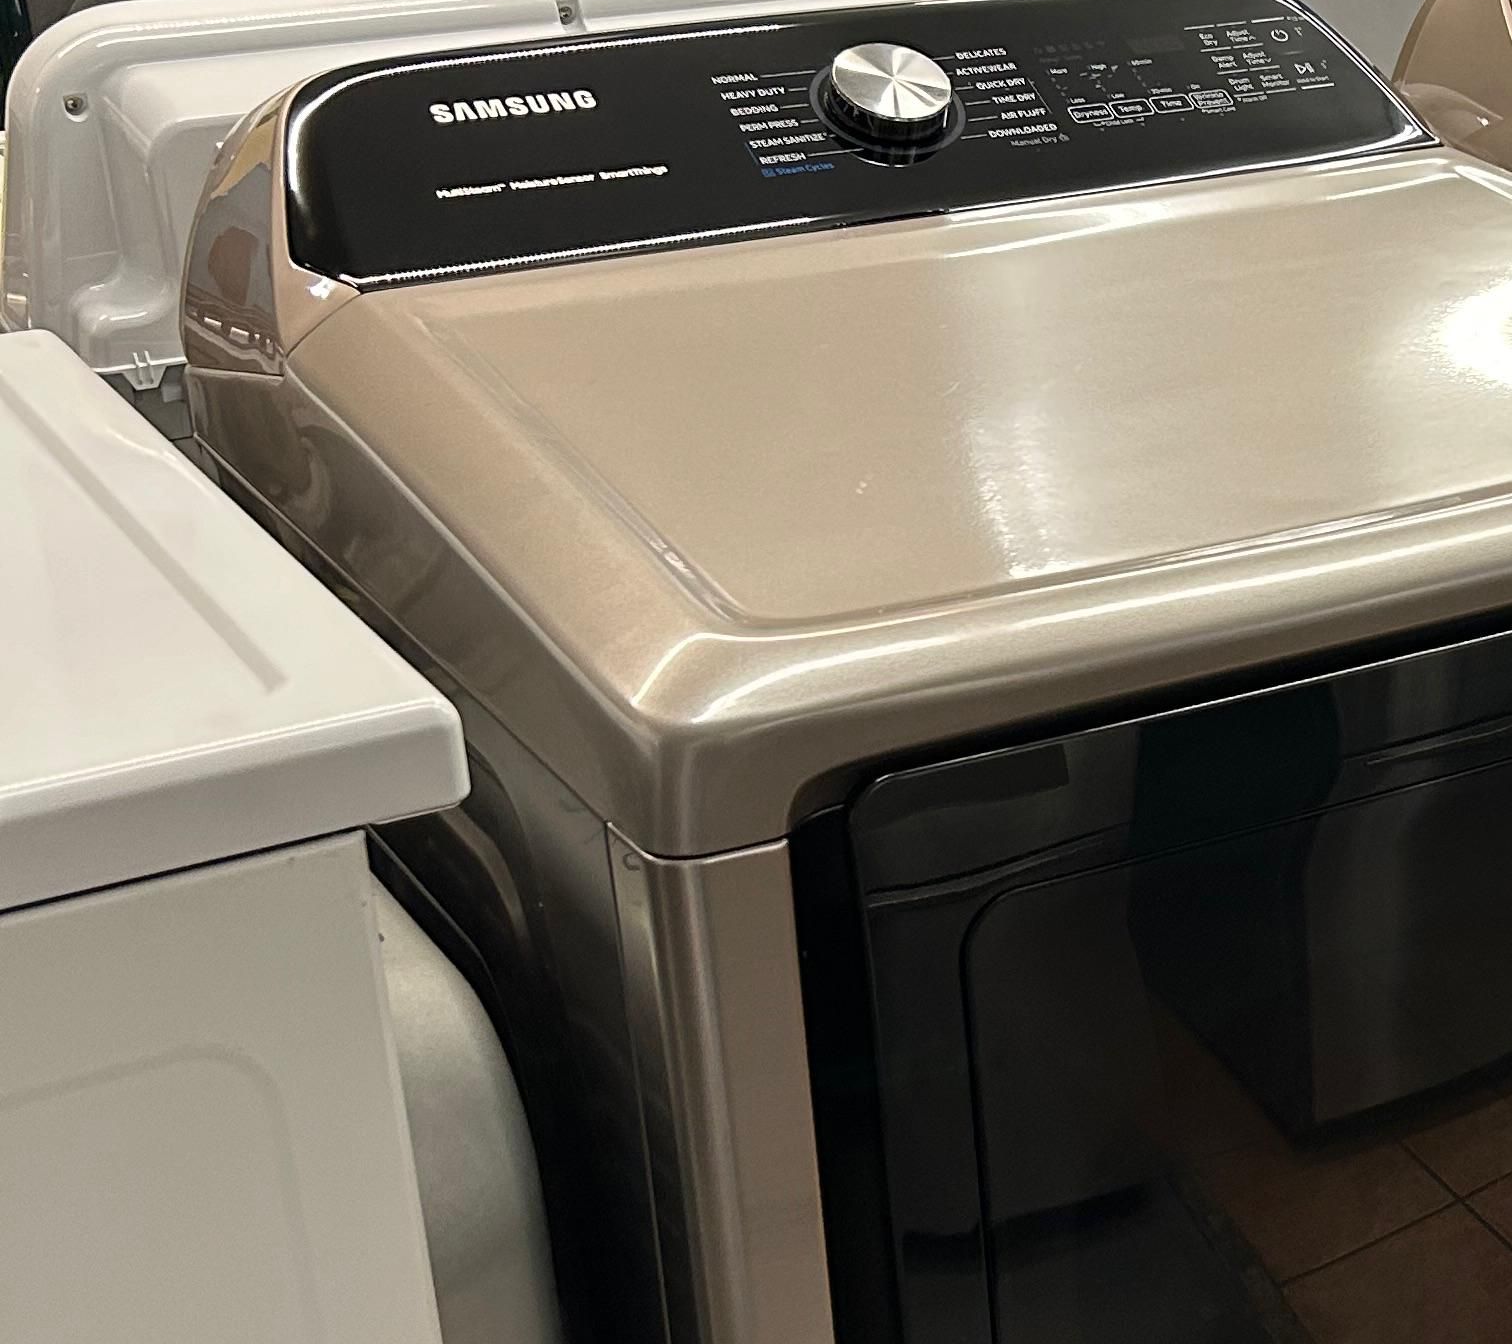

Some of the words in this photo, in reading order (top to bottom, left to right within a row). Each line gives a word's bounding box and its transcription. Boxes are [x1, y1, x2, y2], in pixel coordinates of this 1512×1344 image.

[955, 48, 1007, 60] DELICATES
[956, 62, 1017, 76] ACTIVEWEAR
[711, 73, 758, 84] NORMAL
[976, 80, 1006, 90] QUICK
[1006, 77, 1025, 86] DRY
[720, 90, 756, 100] HEAVY
[757, 86, 785, 97] DUTY
[992, 95, 1017, 104] TIME
[1016, 93, 1035, 102] DRY
[429, 90, 597, 124] SAMSUNG
[729, 104, 779, 116] BEDDING
[1001, 111, 1018, 120] AIR
[1017, 107, 1046, 118] FLUFF
[739, 122, 768, 132] PERM
[768, 119, 799, 129] PRESS
[988, 123, 1058, 138] DOWNLOADED
[749, 137, 783, 149] STEAM
[759, 152, 806, 164] REFRESH
